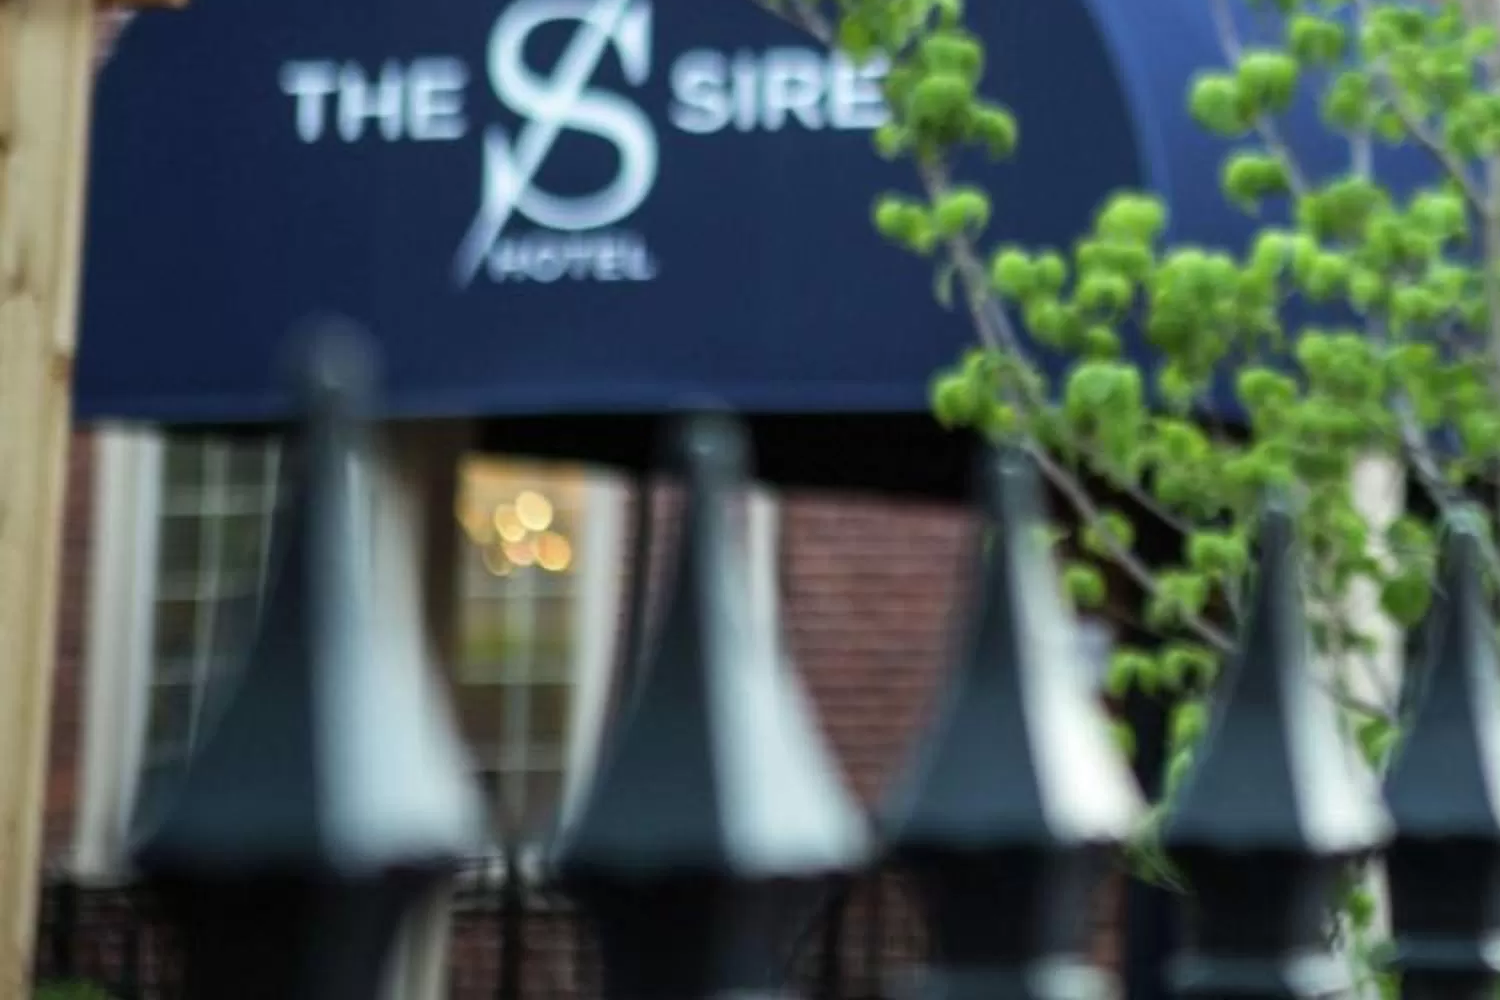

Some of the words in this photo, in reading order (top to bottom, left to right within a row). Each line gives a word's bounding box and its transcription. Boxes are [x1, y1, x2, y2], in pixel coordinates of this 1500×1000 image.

[281, 58, 468, 142] THE
[670, 48, 890, 134] SIRE
[489, 236, 658, 283] HOTEL
